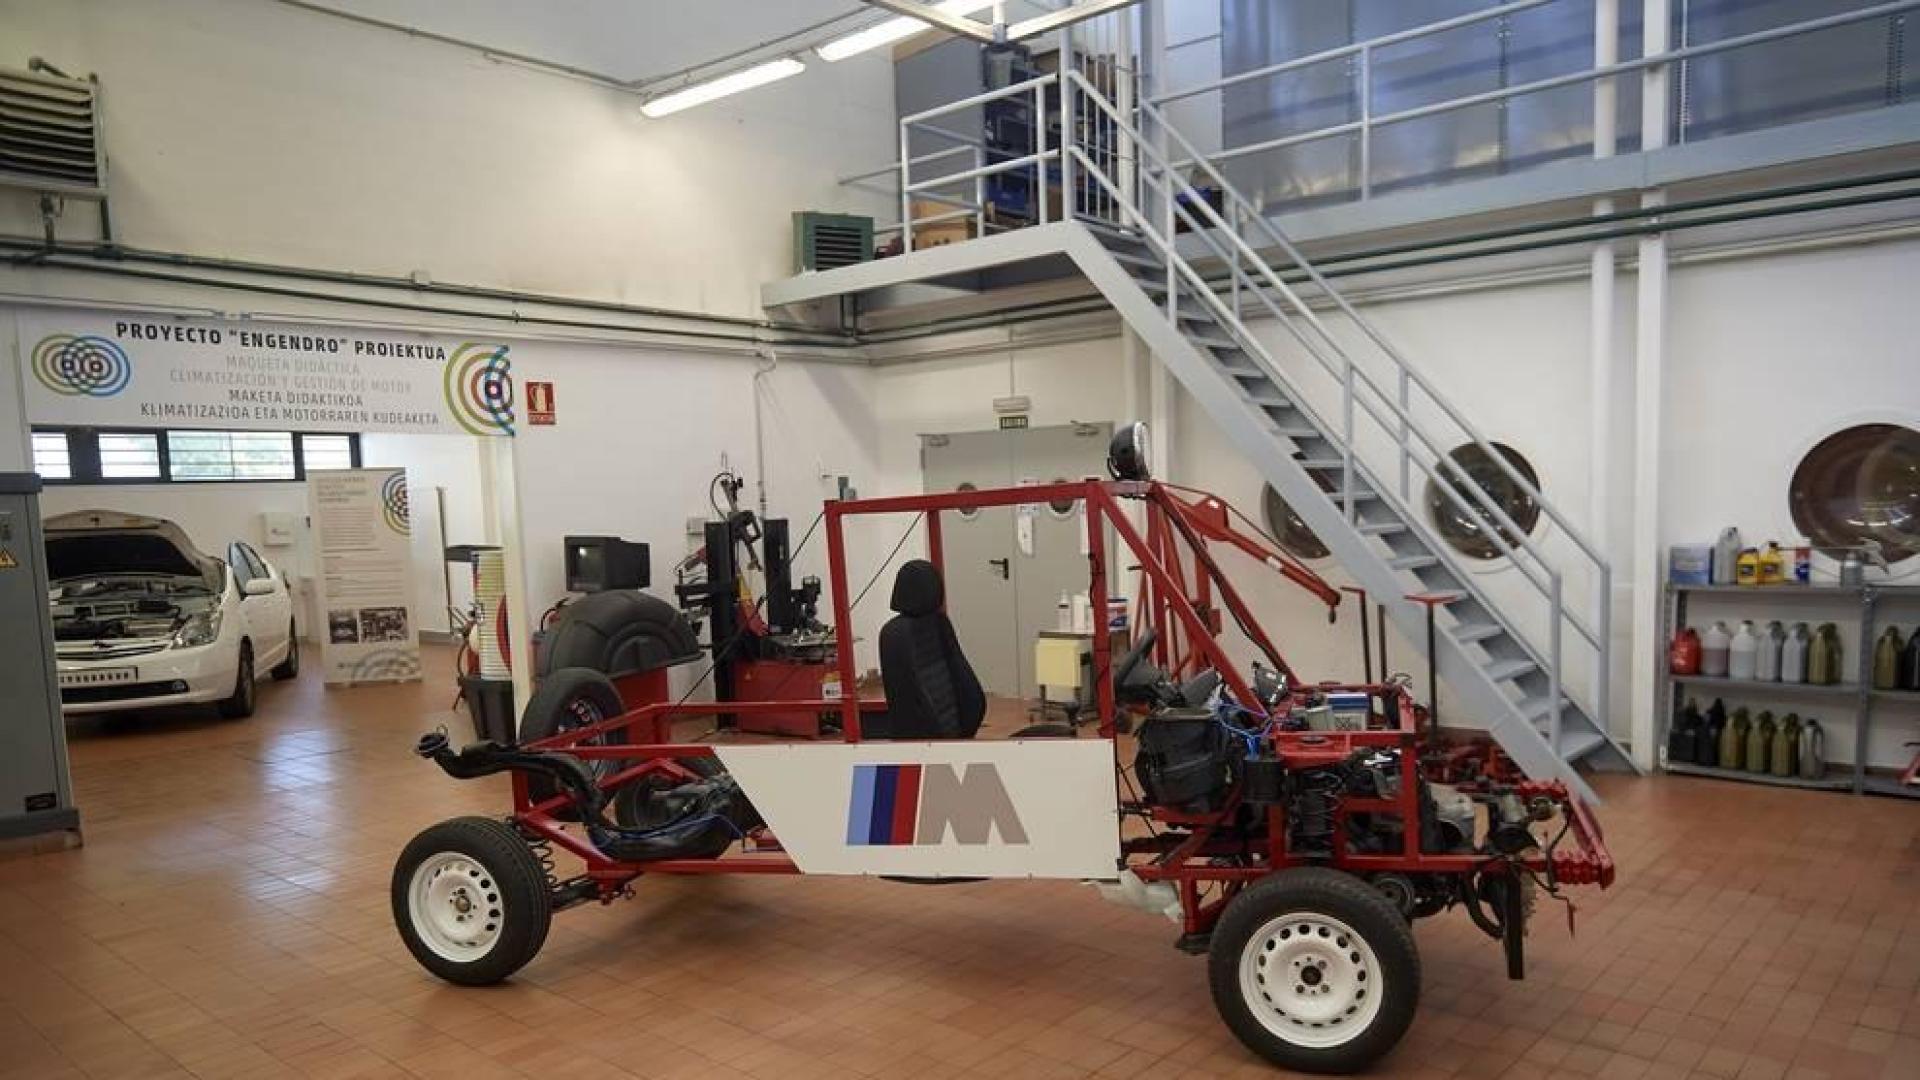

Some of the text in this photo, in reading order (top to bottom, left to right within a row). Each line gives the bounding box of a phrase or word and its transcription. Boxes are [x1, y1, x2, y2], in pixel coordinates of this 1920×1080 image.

[115, 322, 446, 360] PROYECTO "ENGENDRO" PROIEKTUA
[226, 355, 289, 371] MAQUETA
[228, 389, 363, 406] MAKETA DIDAKTIKOA
[140, 403, 439, 424] KLIMATIZAZIOA ETA MOTORRAREN KUDEAKETA
